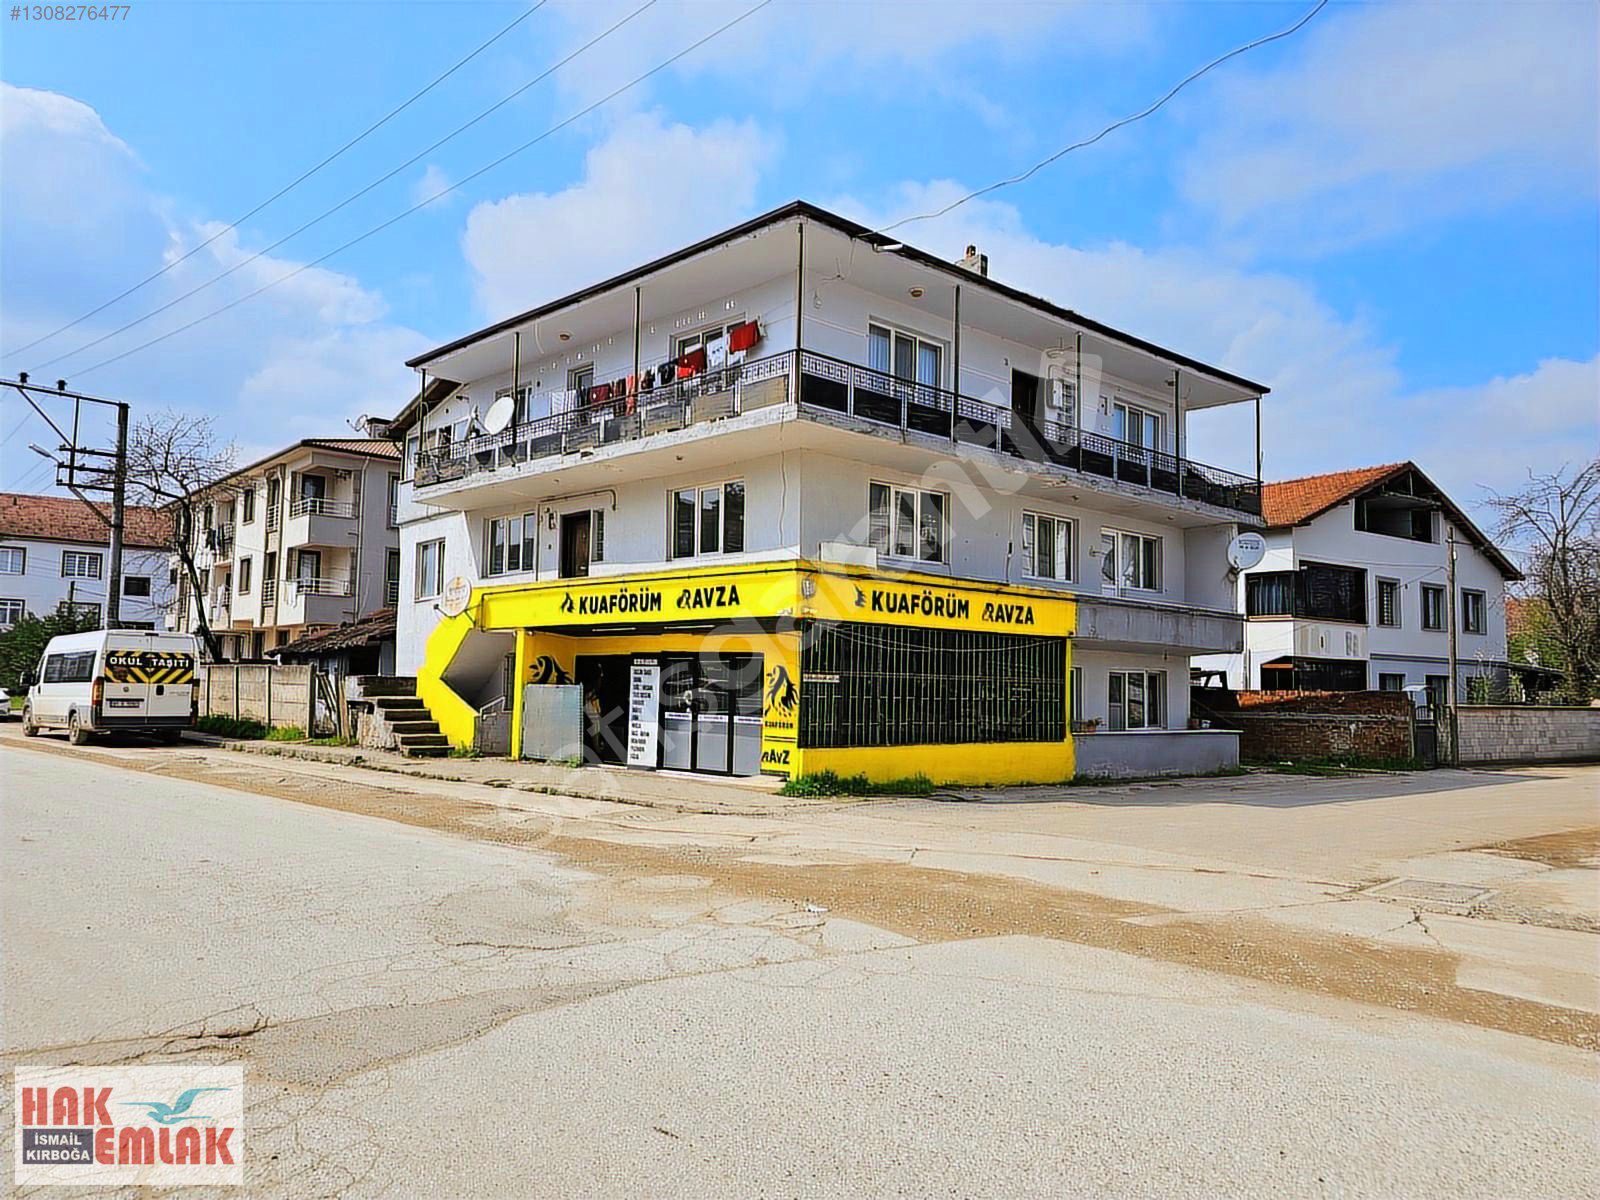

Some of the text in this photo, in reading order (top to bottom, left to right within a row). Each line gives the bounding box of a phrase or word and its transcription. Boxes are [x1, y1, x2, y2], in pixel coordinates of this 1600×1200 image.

[578, 585, 740, 615] KUAFÖRÜM RAVZA
[871, 590, 1035, 625] KUAFÖRÜM RAVZA
[110, 657, 143, 666] OKUL
